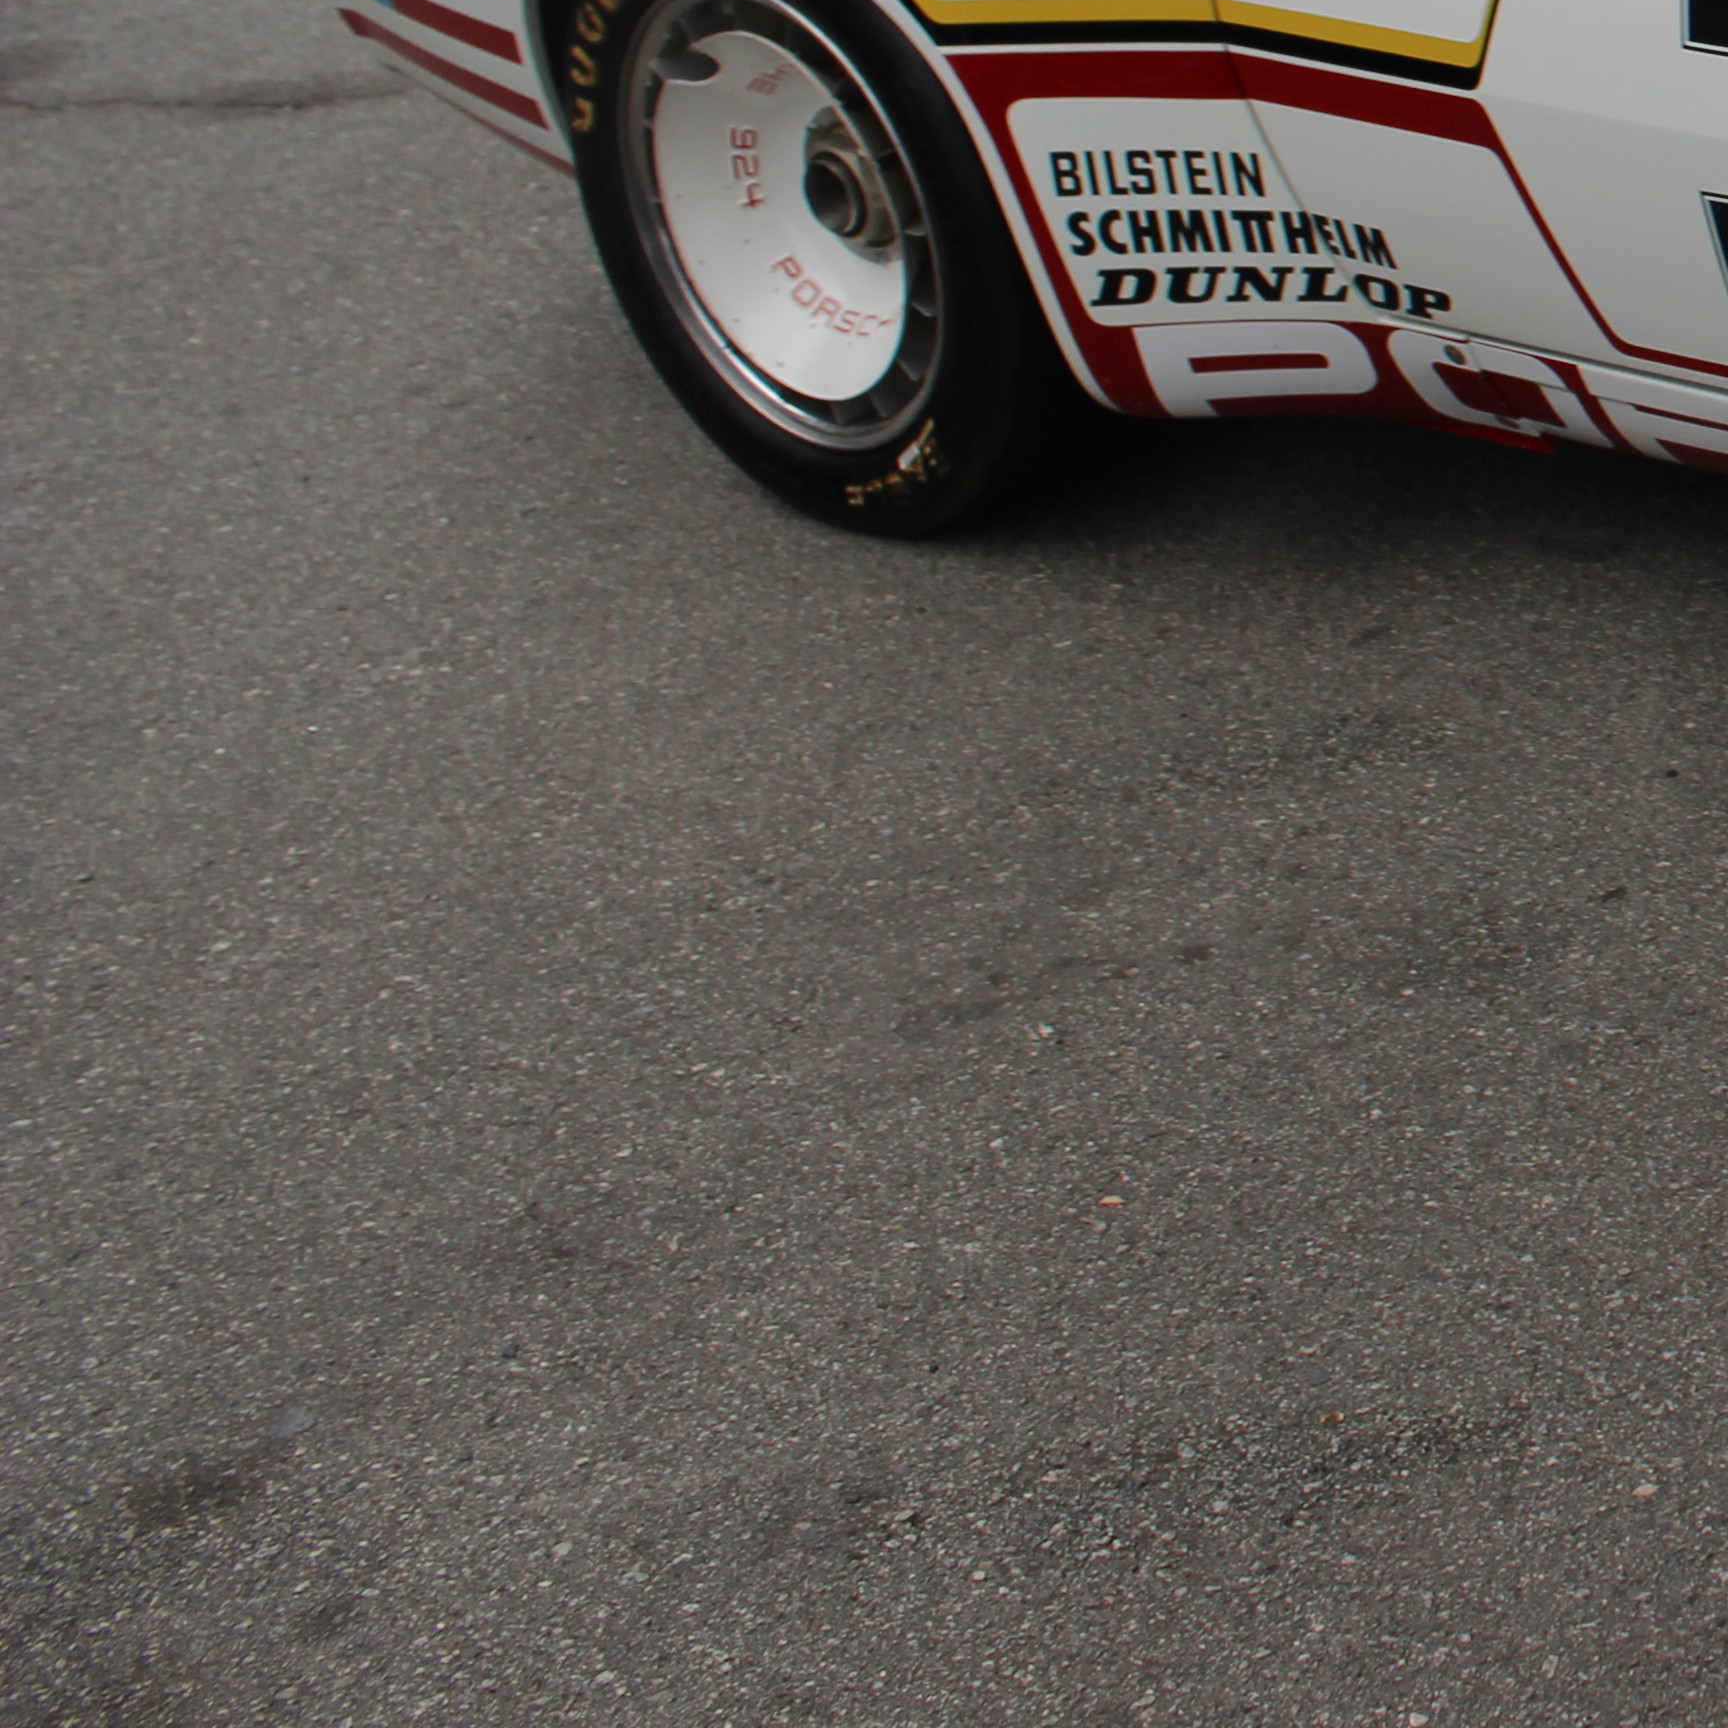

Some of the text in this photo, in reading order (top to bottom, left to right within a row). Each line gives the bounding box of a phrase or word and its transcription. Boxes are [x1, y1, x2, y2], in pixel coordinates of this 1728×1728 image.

[729, 126, 766, 209] 924
[1049, 149, 1265, 198] BILSTEIN
[1066, 208, 1399, 271] SCHMITTHELM
[770, 256, 893, 337] PORSC
[1089, 265, 1452, 320] DUNLOP
